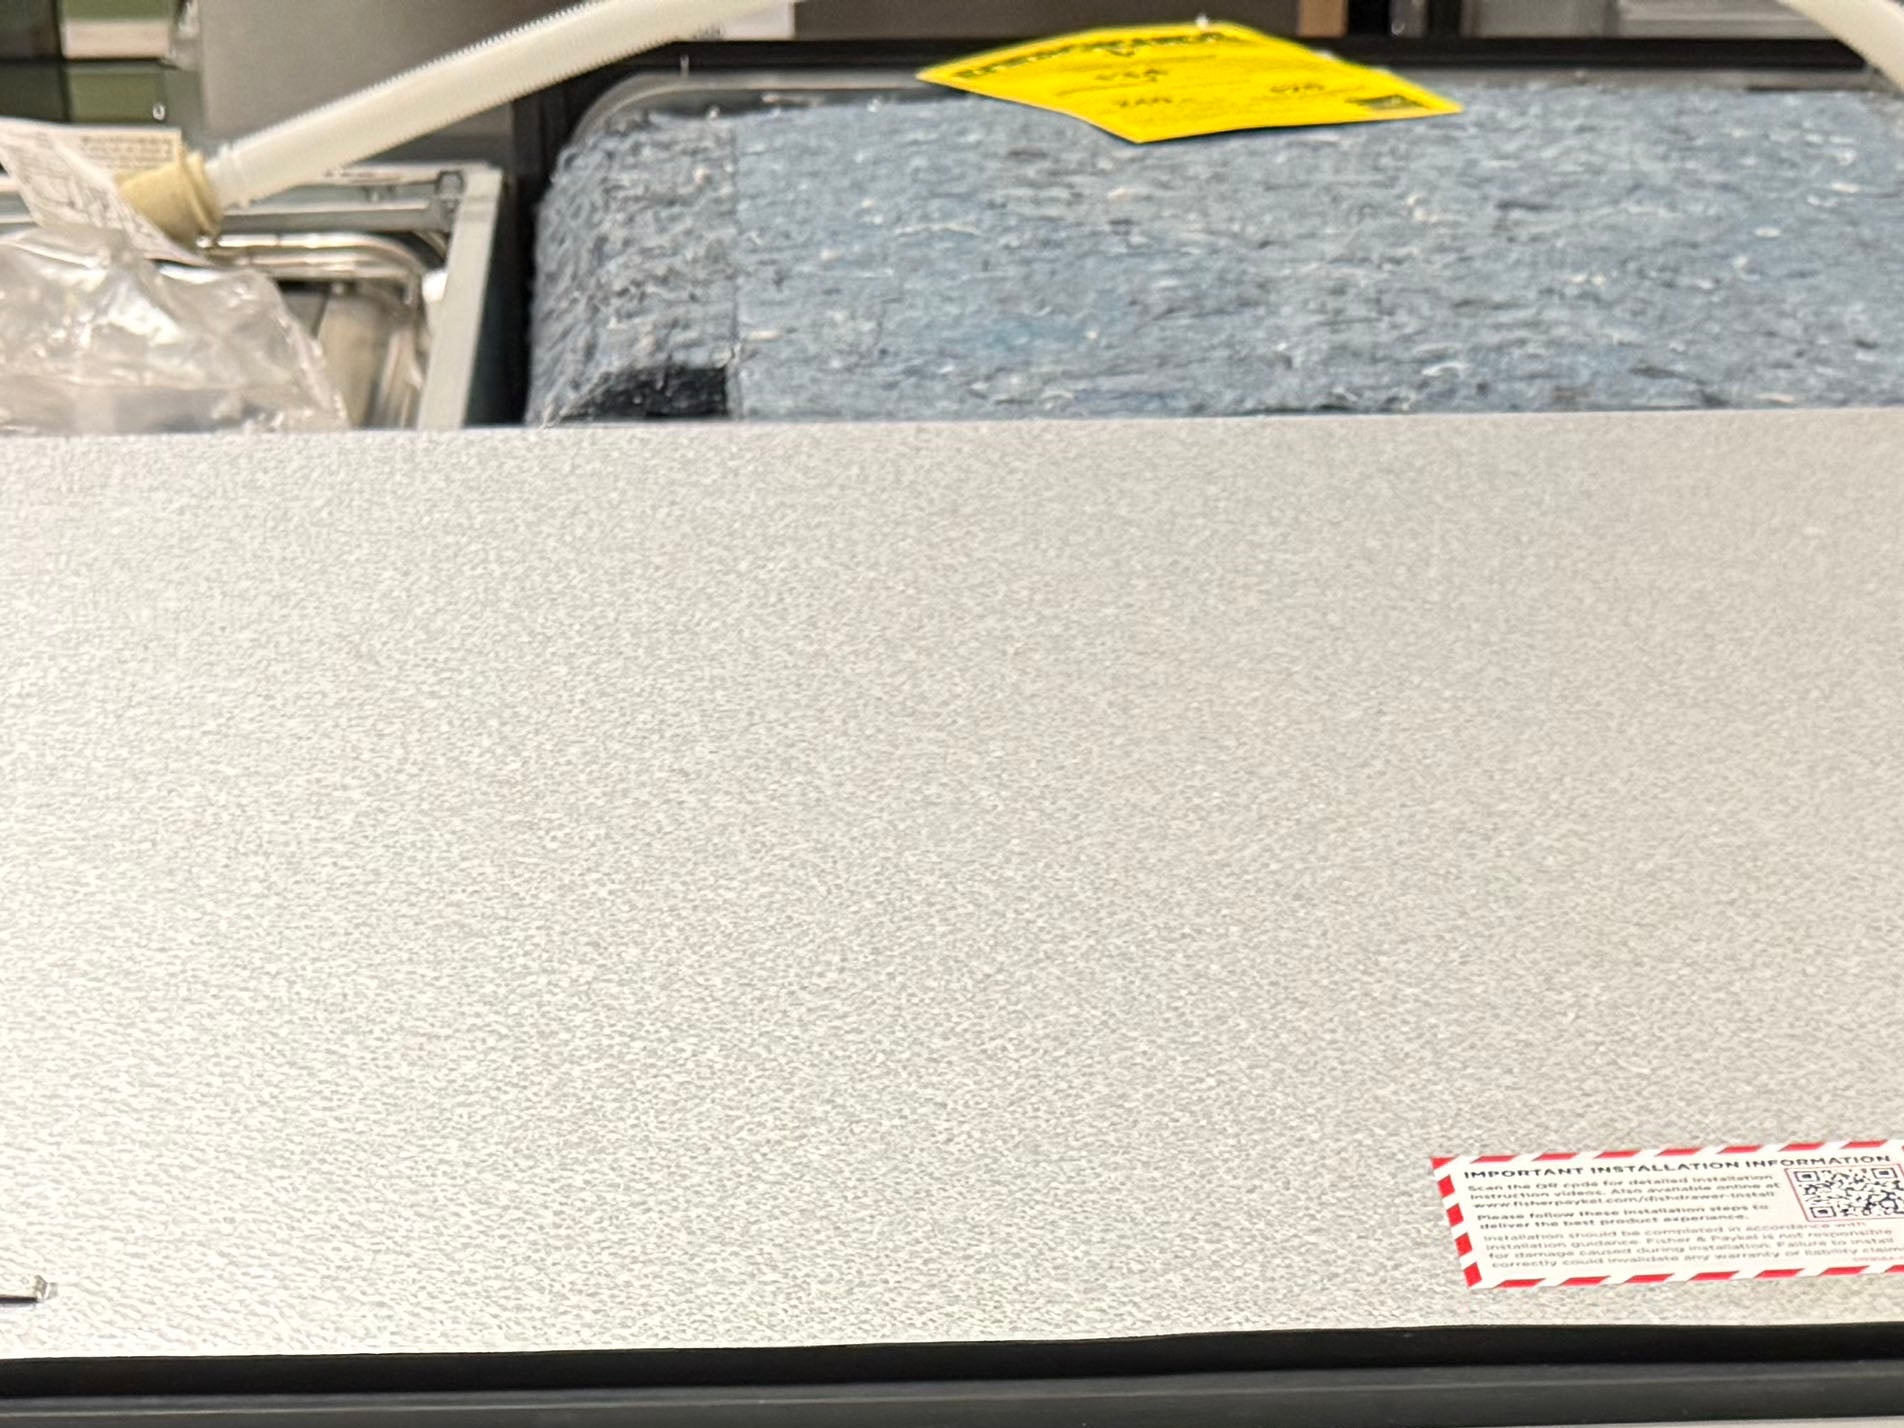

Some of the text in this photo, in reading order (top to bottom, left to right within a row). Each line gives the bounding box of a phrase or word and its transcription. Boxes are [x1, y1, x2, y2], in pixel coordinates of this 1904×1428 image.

[1463, 1155, 1892, 1178] IMPORTANT INSTALLATION INFORMATION
